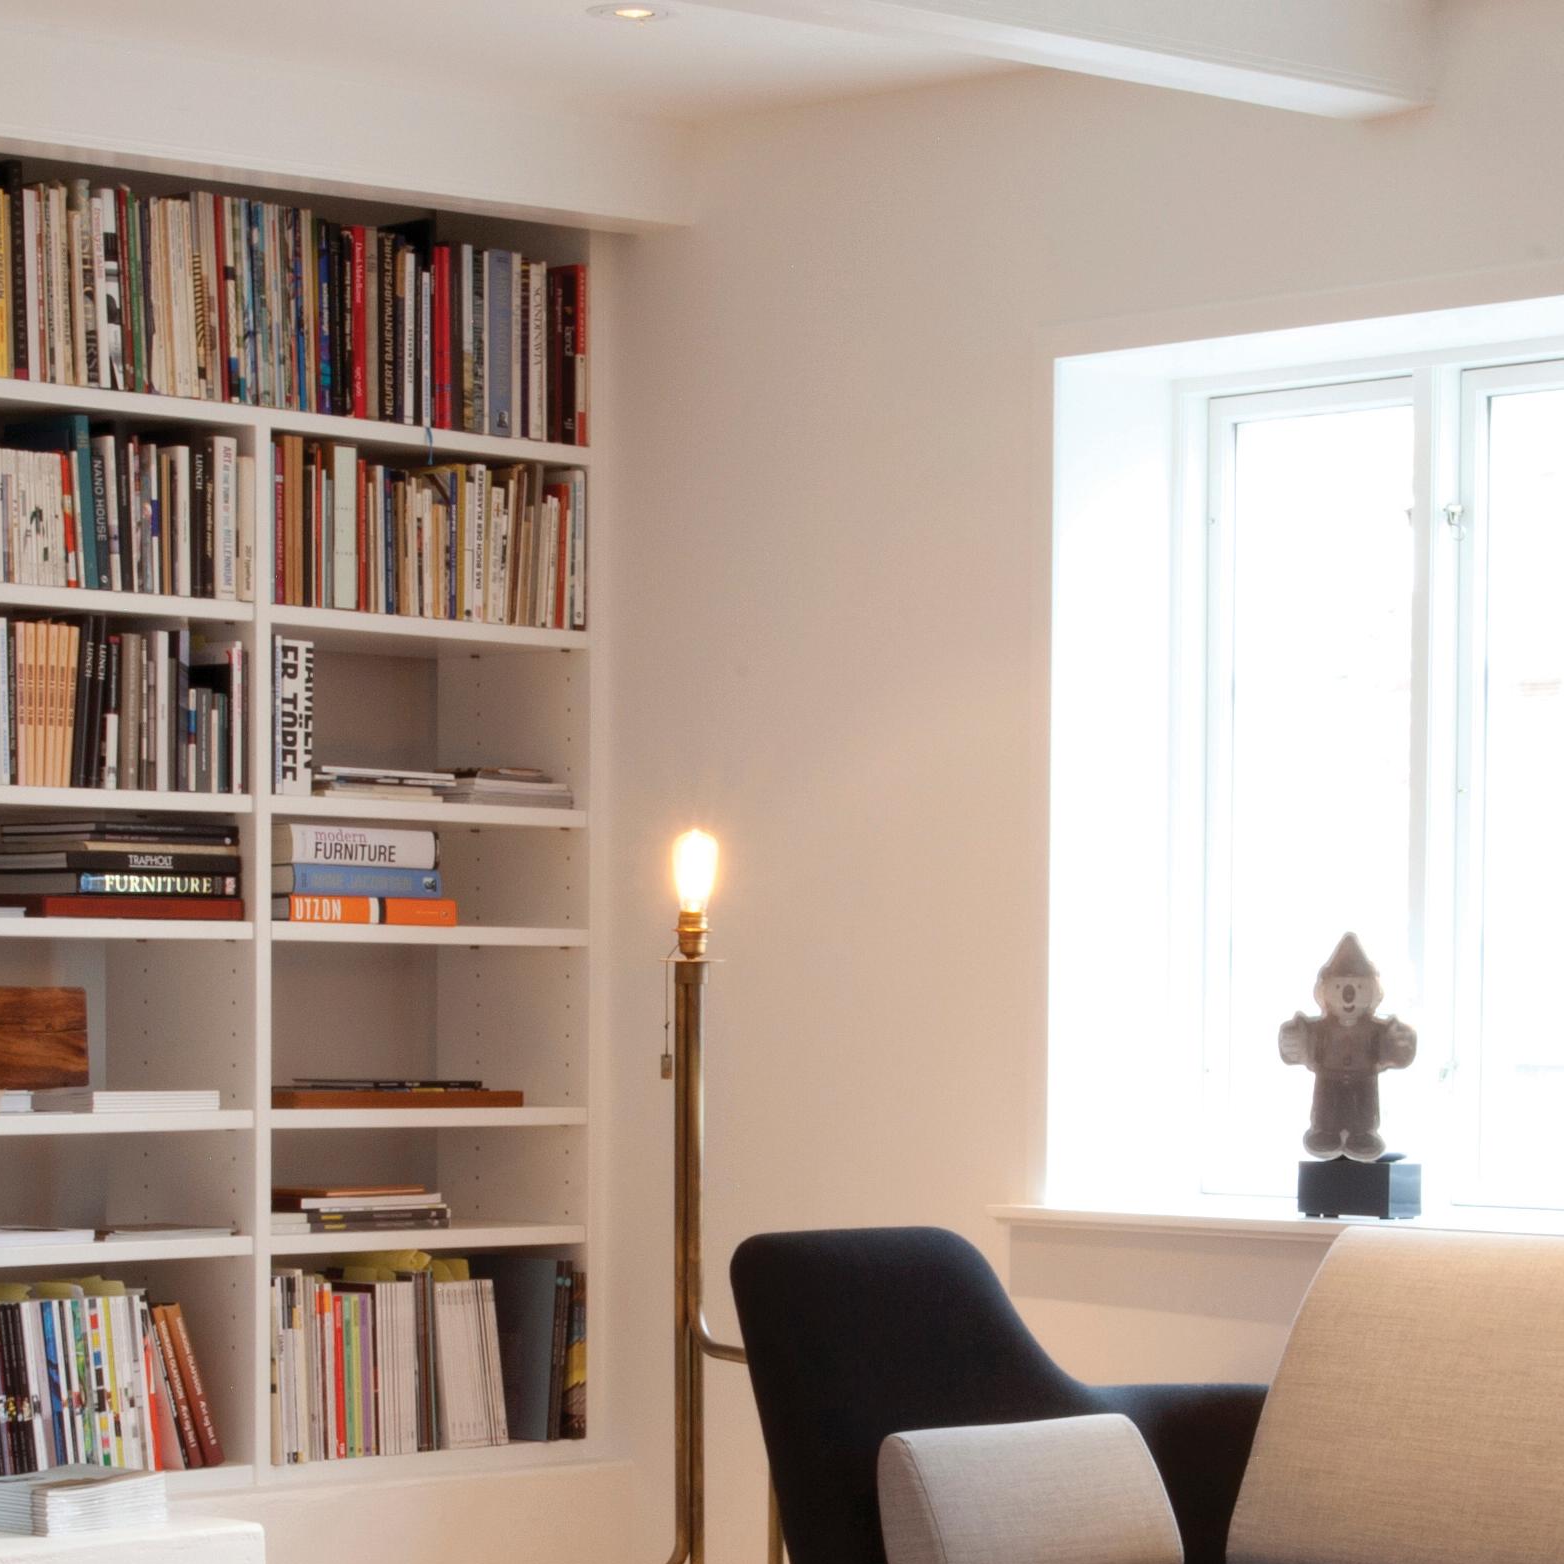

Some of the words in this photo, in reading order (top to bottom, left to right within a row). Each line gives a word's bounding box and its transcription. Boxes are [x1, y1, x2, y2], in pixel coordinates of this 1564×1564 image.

[384, 238, 395, 361] BAUENTWURFSLEHRE
[385, 361, 394, 416] NEUFERT
[222, 446, 232, 464] ART
[93, 459, 105, 496] NANO
[195, 453, 204, 491] LUNCH
[477, 470, 486, 521] KLASSIKER
[96, 499, 108, 542] HOUSE
[476, 522, 484, 542] DER
[222, 528, 233, 586] MILLENNIUM
[475, 543, 484, 569] BUCH
[475, 570, 483, 590] DAS
[85, 641, 94, 678] LUNCH
[97, 643, 107, 681] LUNCH
[314, 829, 368, 843] modern
[128, 854, 174, 867] TRAPHOLT
[313, 841, 397, 863] FURNITURE
[103, 874, 213, 894] FURNITURE
[294, 898, 343, 921] UTZON
